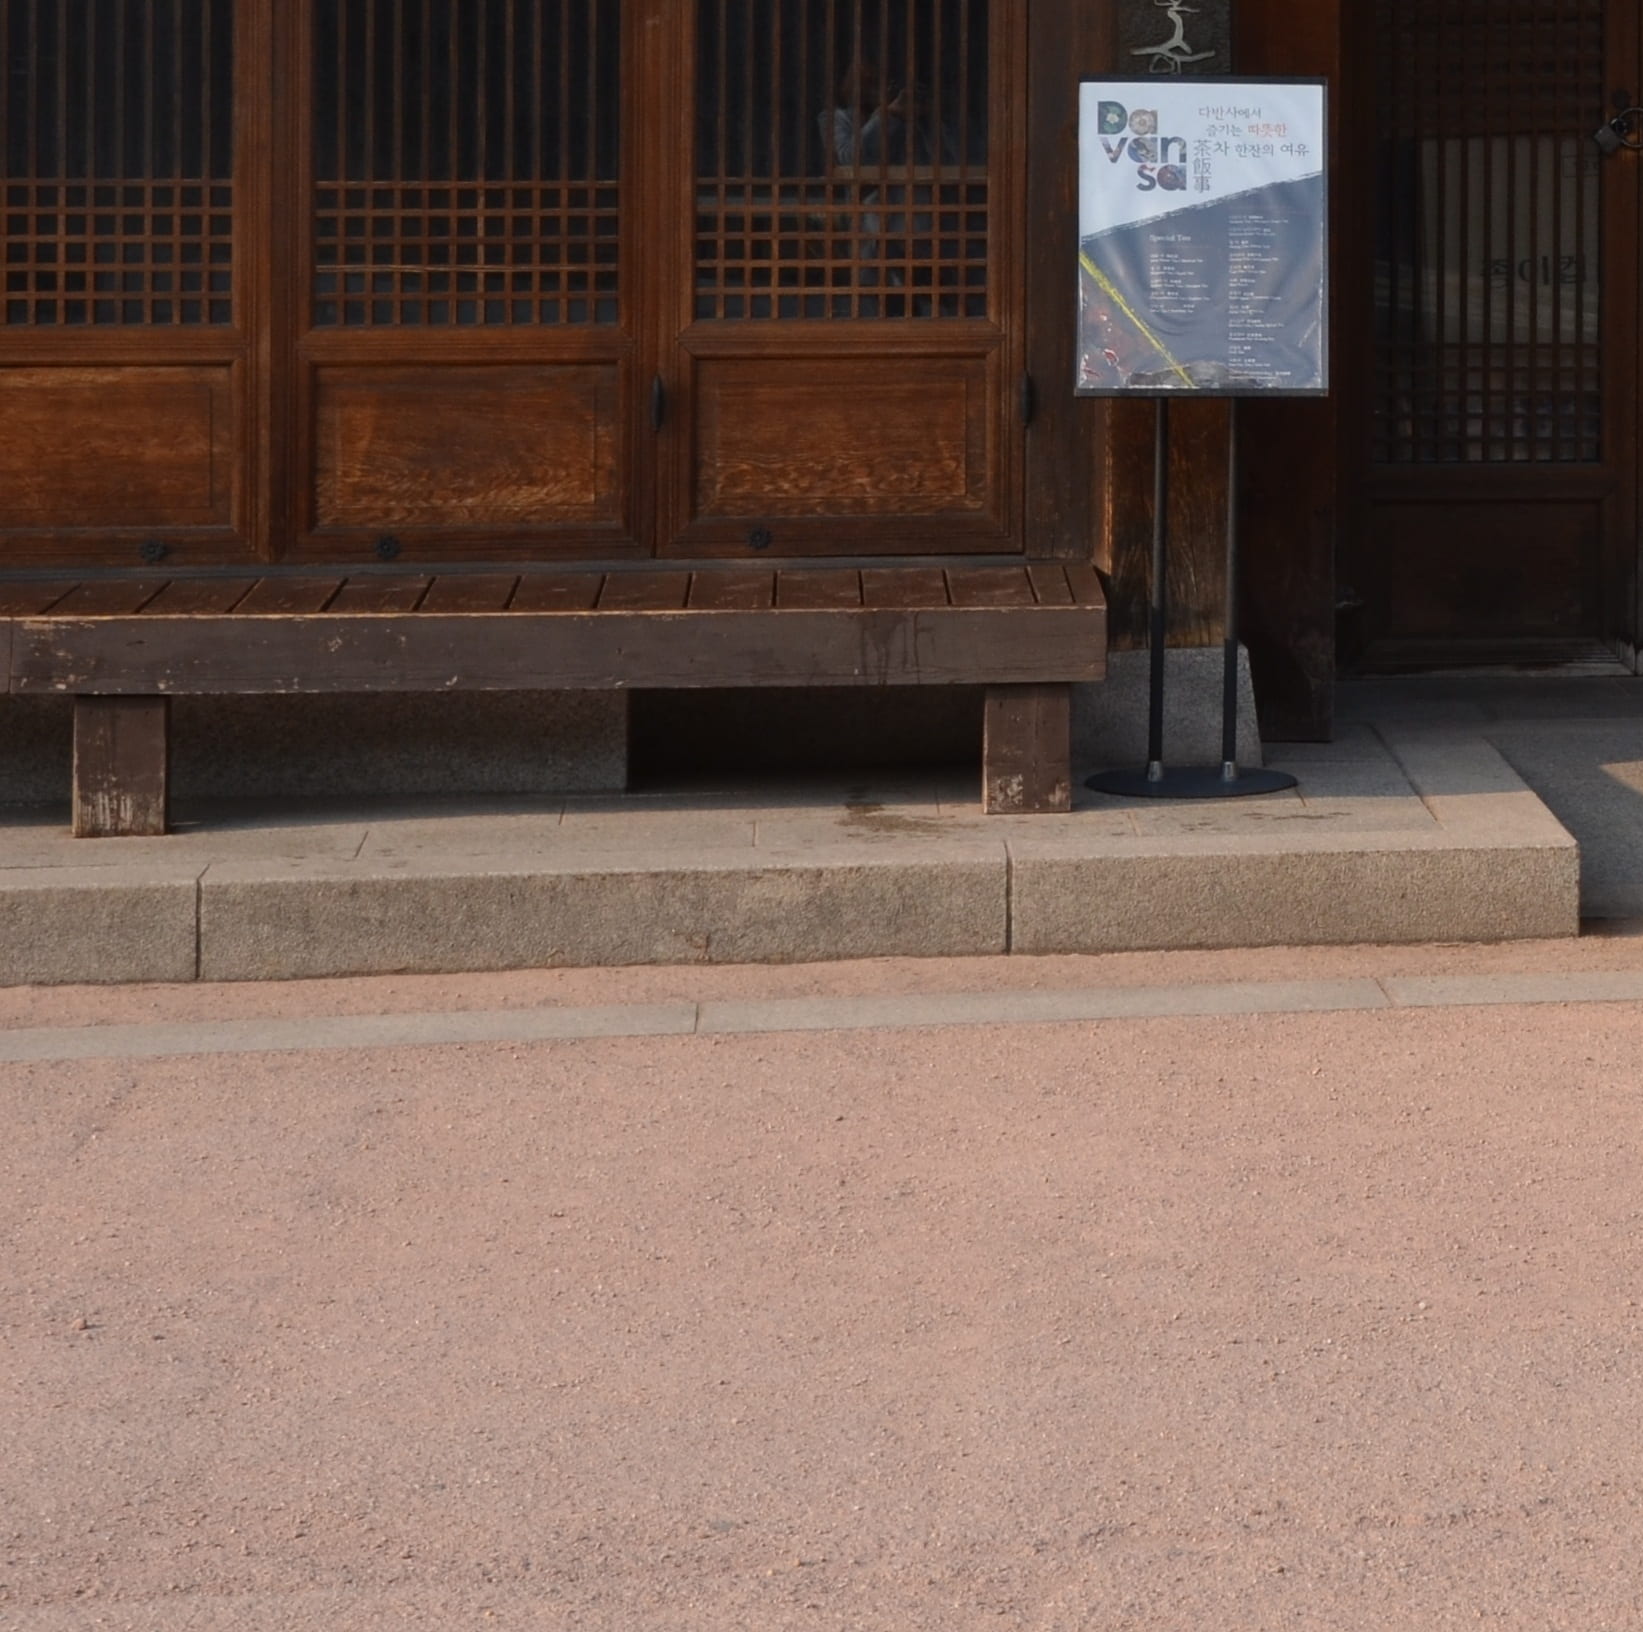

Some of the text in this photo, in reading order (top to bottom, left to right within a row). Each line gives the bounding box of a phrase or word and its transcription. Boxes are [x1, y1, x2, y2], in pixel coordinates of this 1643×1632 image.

[1248, 123, 1288, 137] 따뜻한
[1235, 143, 1275, 158] 한잔의
[1280, 143, 1310, 157] 여유
